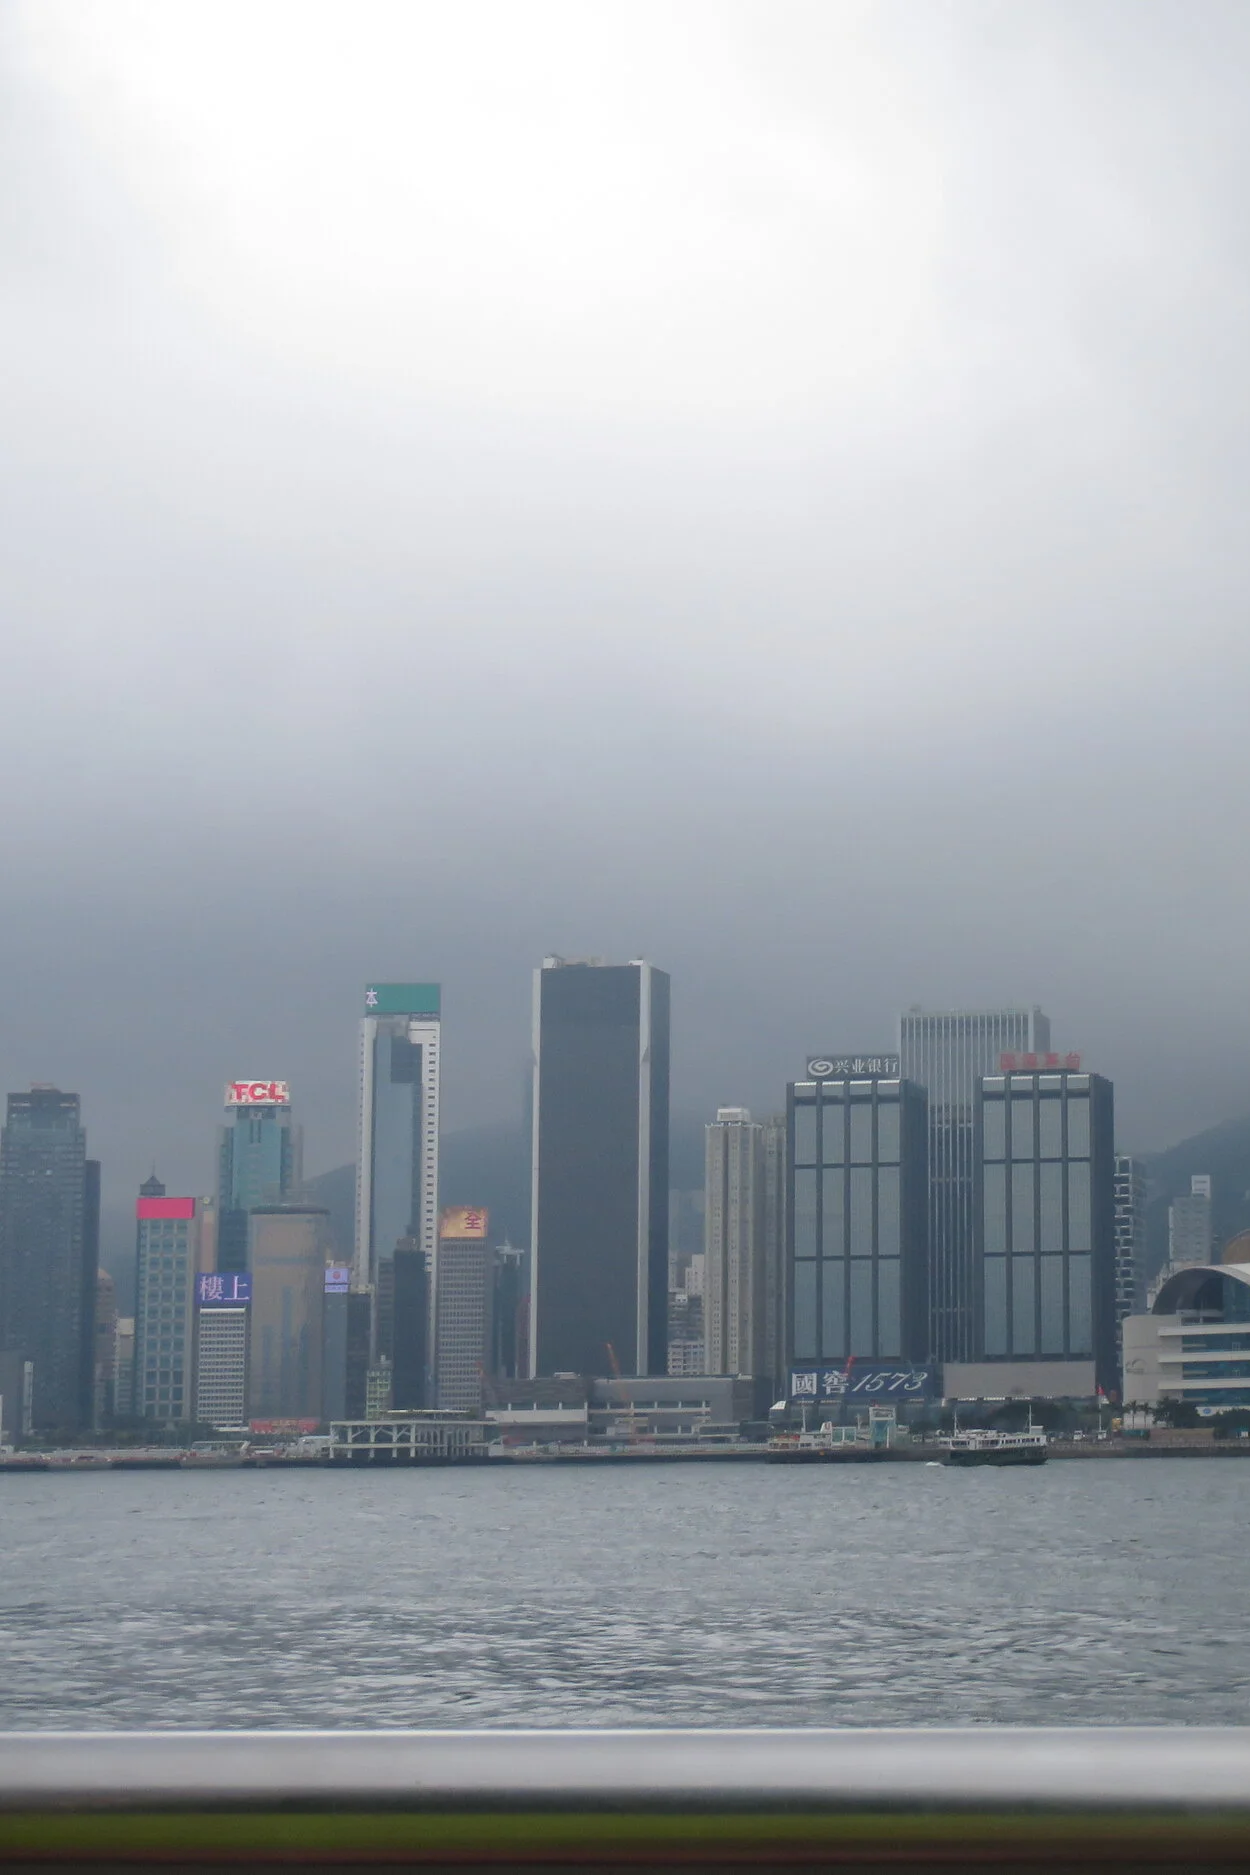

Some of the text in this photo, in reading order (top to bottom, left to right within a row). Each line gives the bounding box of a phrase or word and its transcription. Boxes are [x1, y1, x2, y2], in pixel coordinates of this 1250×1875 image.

[834, 1058, 898, 1074] 兴业银行
[231, 1083, 284, 1100] TCL
[200, 1275, 250, 1301] 樓上
